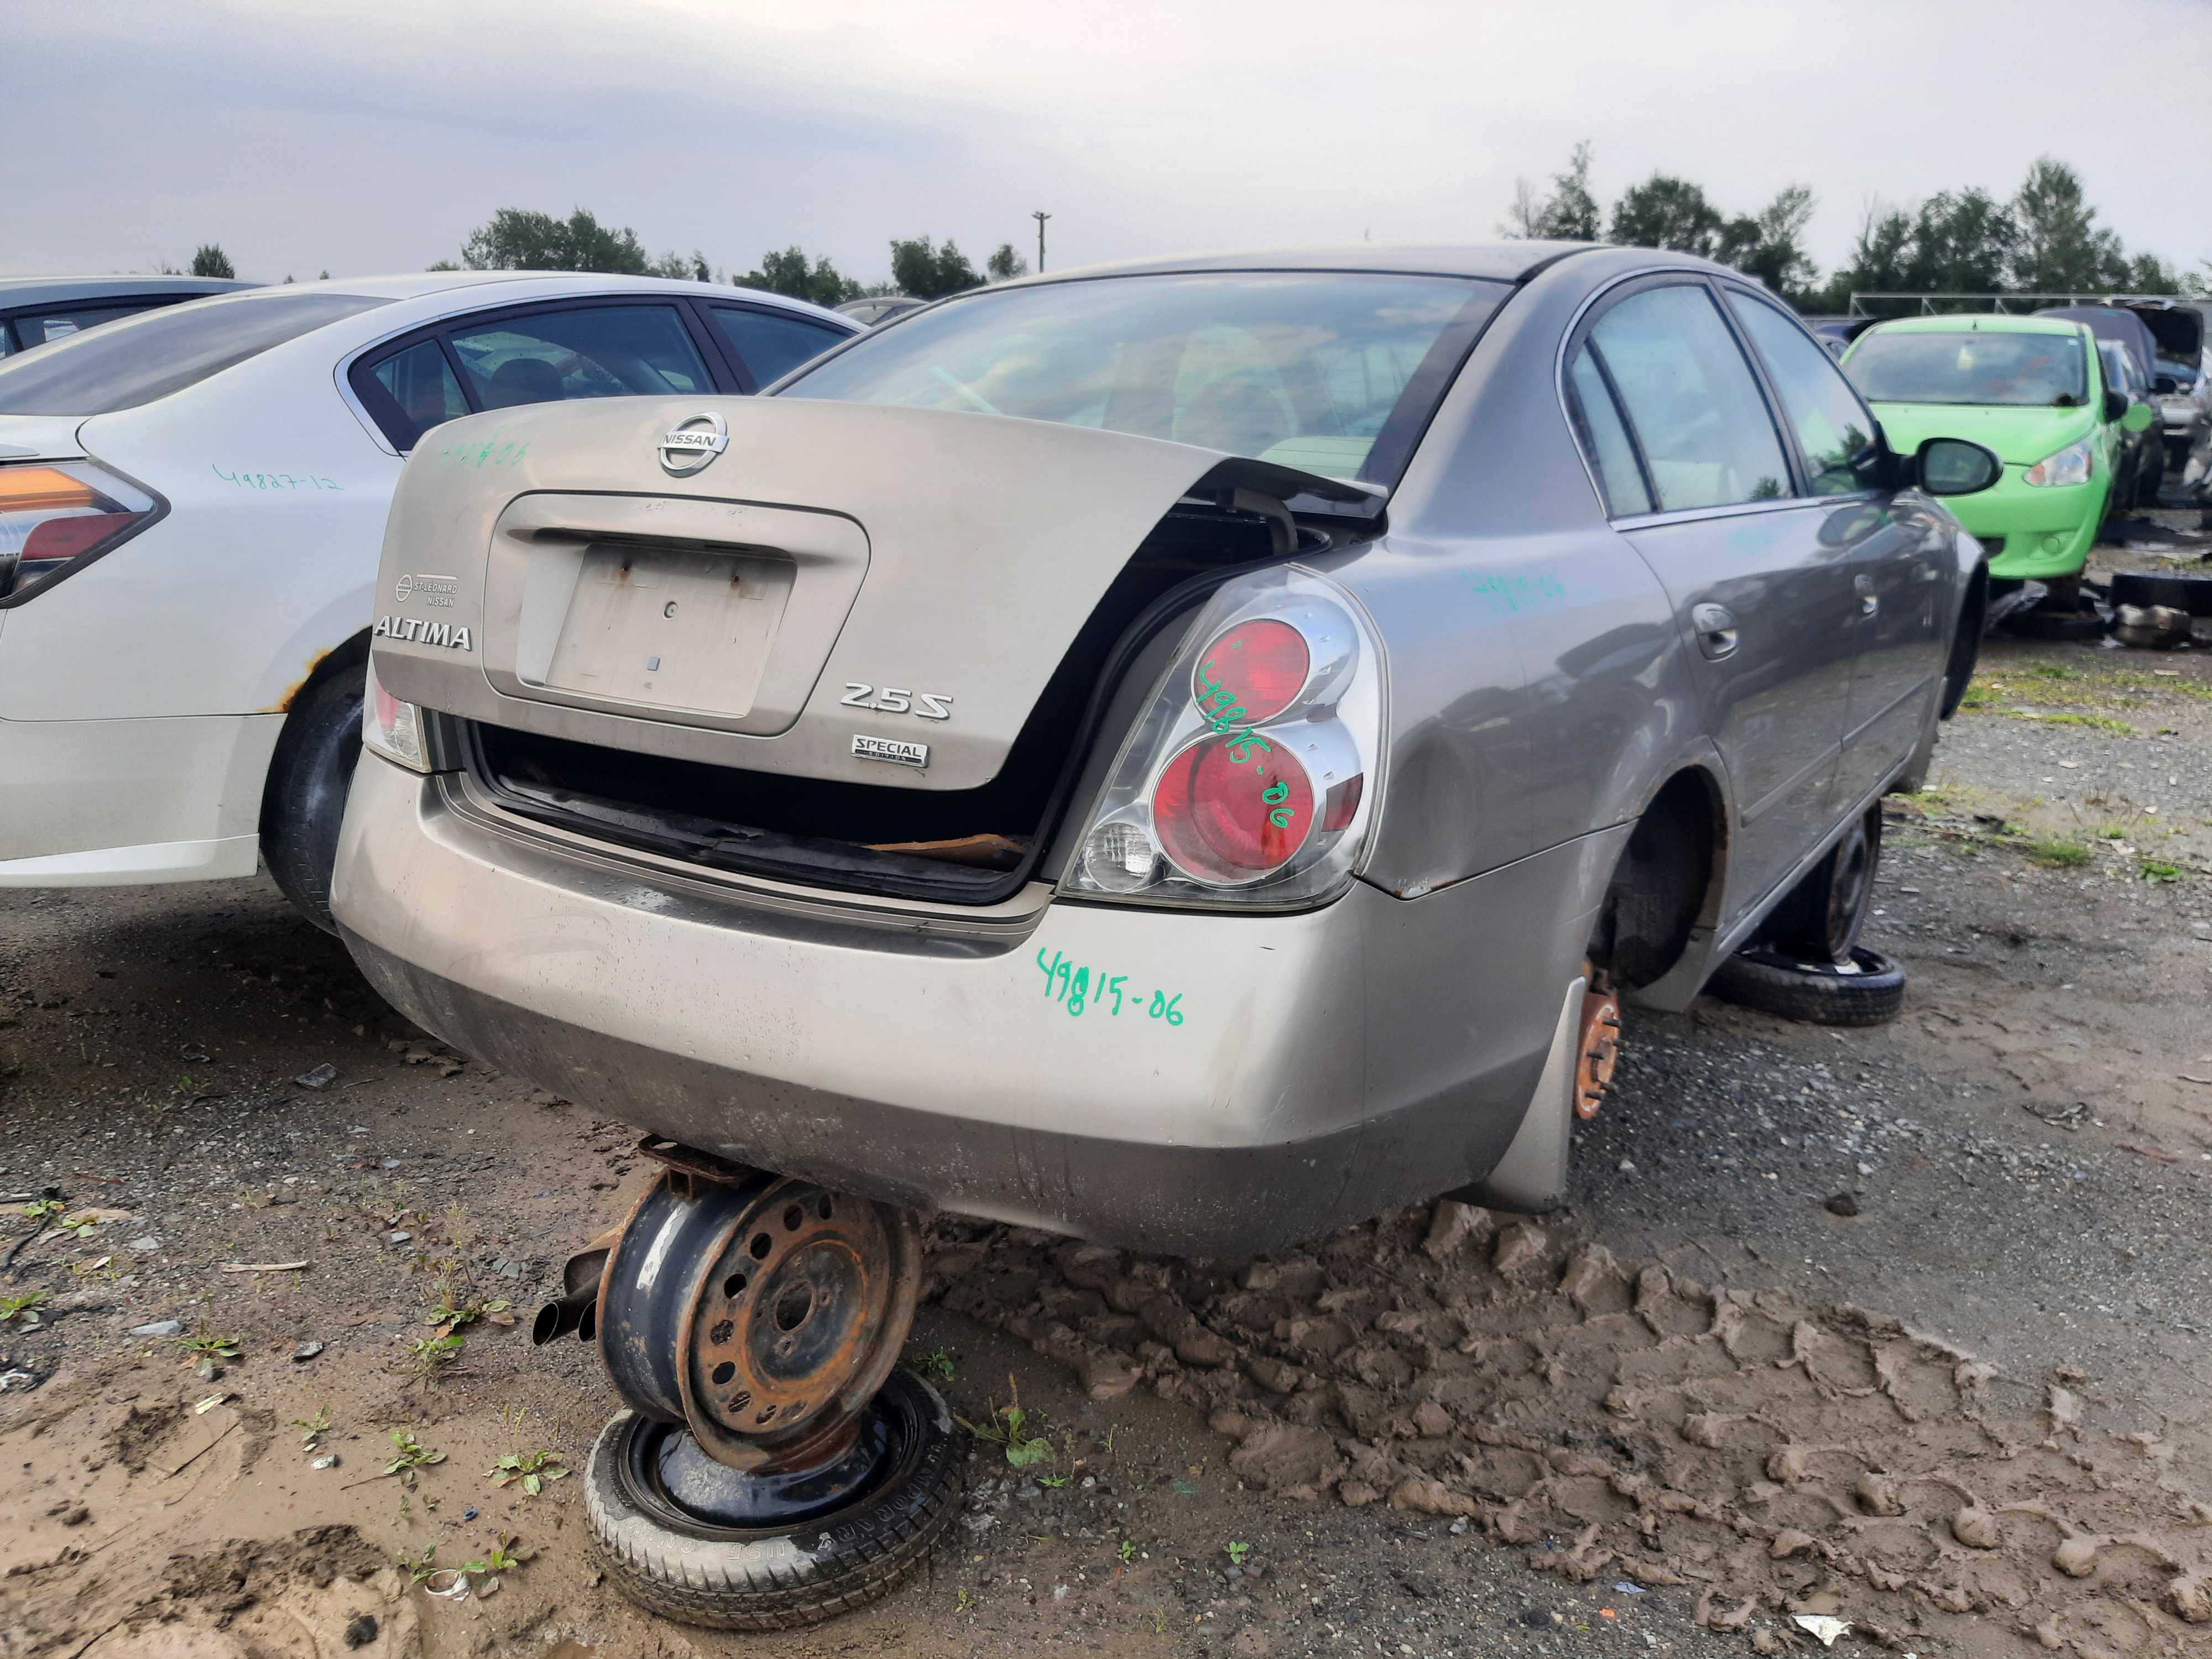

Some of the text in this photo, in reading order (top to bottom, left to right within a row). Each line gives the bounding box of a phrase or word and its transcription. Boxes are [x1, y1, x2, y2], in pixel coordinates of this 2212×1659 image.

[664, 435, 717, 447] NISSAN
[212, 463, 344, 490] 49827-12
[427, 597, 455, 607] NISSAN
[374, 615, 472, 651] ALTIMA
[915, 693, 953, 721] S
[855, 738, 922, 758] SPECIAL
[869, 751, 907, 761] EDITION
[1036, 946, 1185, 1026] 49815-06
[625, 1521, 697, 1555] ONLY
[724, 1543, 787, 1562] USE
